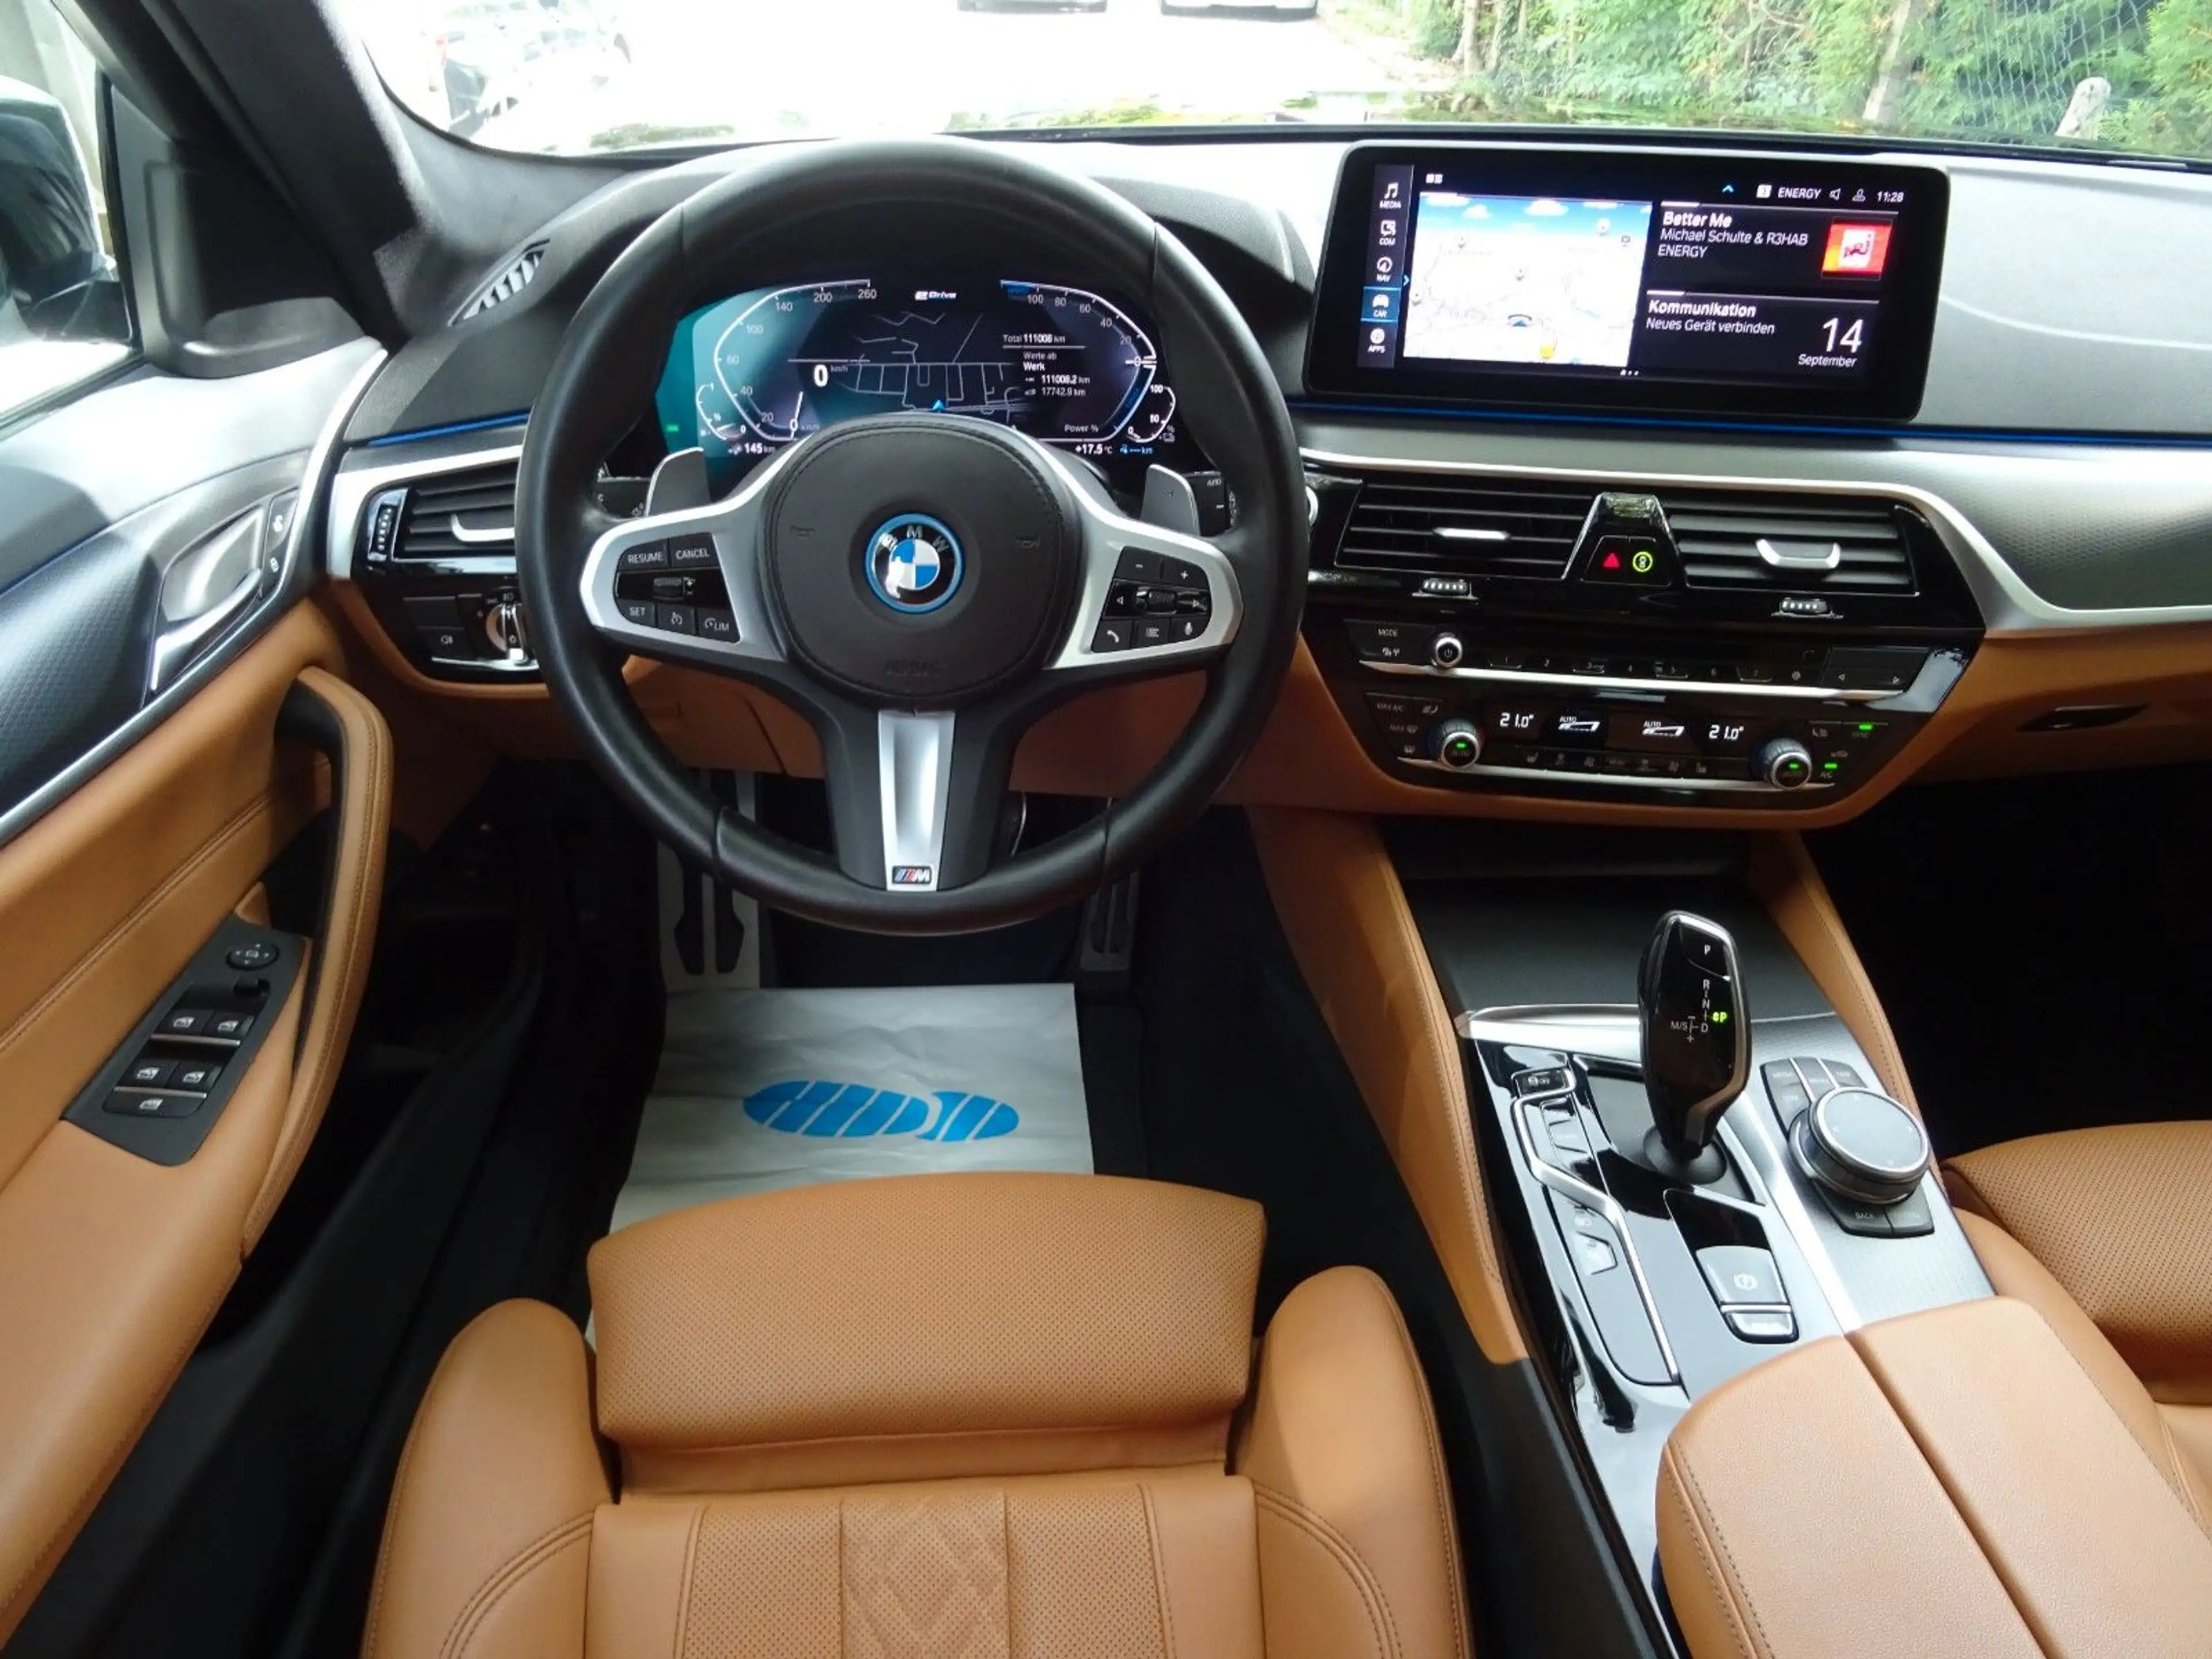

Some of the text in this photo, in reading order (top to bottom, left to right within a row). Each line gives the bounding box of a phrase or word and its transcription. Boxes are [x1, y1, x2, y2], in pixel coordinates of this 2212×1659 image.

[1778, 186, 1821, 199] ENERGY
[1877, 191, 1904, 203] 11:28
[1380, 200, 1402, 209] MEDIA
[1663, 211, 1733, 228] Better Me
[1379, 237, 1396, 246] COM
[1660, 229, 1809, 247] Michael Schulte & R3HAB
[1658, 245, 1708, 259] ENERGY
[1377, 274, 1391, 282] NAV
[814, 292, 833, 303] 200
[858, 289, 877, 300] 260
[1027, 294, 1044, 304] 100
[776, 301, 793, 312] 140
[1055, 297, 1067, 306] 80
[1080, 304, 1092, 313] 60
[1648, 298, 1756, 317] Kommunikation
[1373, 309, 1387, 318] CAR
[1100, 318, 1112, 327] 40
[1646, 318, 1775, 335] Neues Gerät verbinden
[746, 324, 764, 335] 100
[1002, 334, 1022, 343] Total
[1054, 335, 1066, 343] km
[1823, 317, 1864, 353] 14
[1120, 336, 1132, 345] 20
[1368, 345, 1385, 353] APPS
[727, 355, 739, 365] 60
[1023, 352, 1058, 361] Werte ab
[1798, 353, 1857, 368] September
[830, 365, 849, 373] km/h
[1023, 362, 1046, 372] Werk
[814, 364, 828, 388] 0
[1078, 376, 1090, 384] km
[741, 385, 753, 395] 40
[1074, 388, 1086, 396] km
[1150, 385, 1164, 393] 100
[762, 411, 774, 422] 20
[740, 425, 747, 434] 0
[789, 419, 799, 432] 0
[1065, 424, 1099, 433] Power %
[1128, 426, 1134, 435] 0
[744, 442, 776, 454] 145 km
[1075, 444, 1103, 455] +17.5
[877, 525, 950, 553] BMW
[628, 551, 664, 565] RESUME
[675, 548, 710, 560] CANCEL
[629, 607, 646, 617] SET
[714, 622, 729, 631] LIM
[1704, 944, 1711, 956] P
[1703, 979, 1710, 989] R
[1702, 998, 1710, 1009] N
[1670, 1020, 1708, 1033] M/S D
